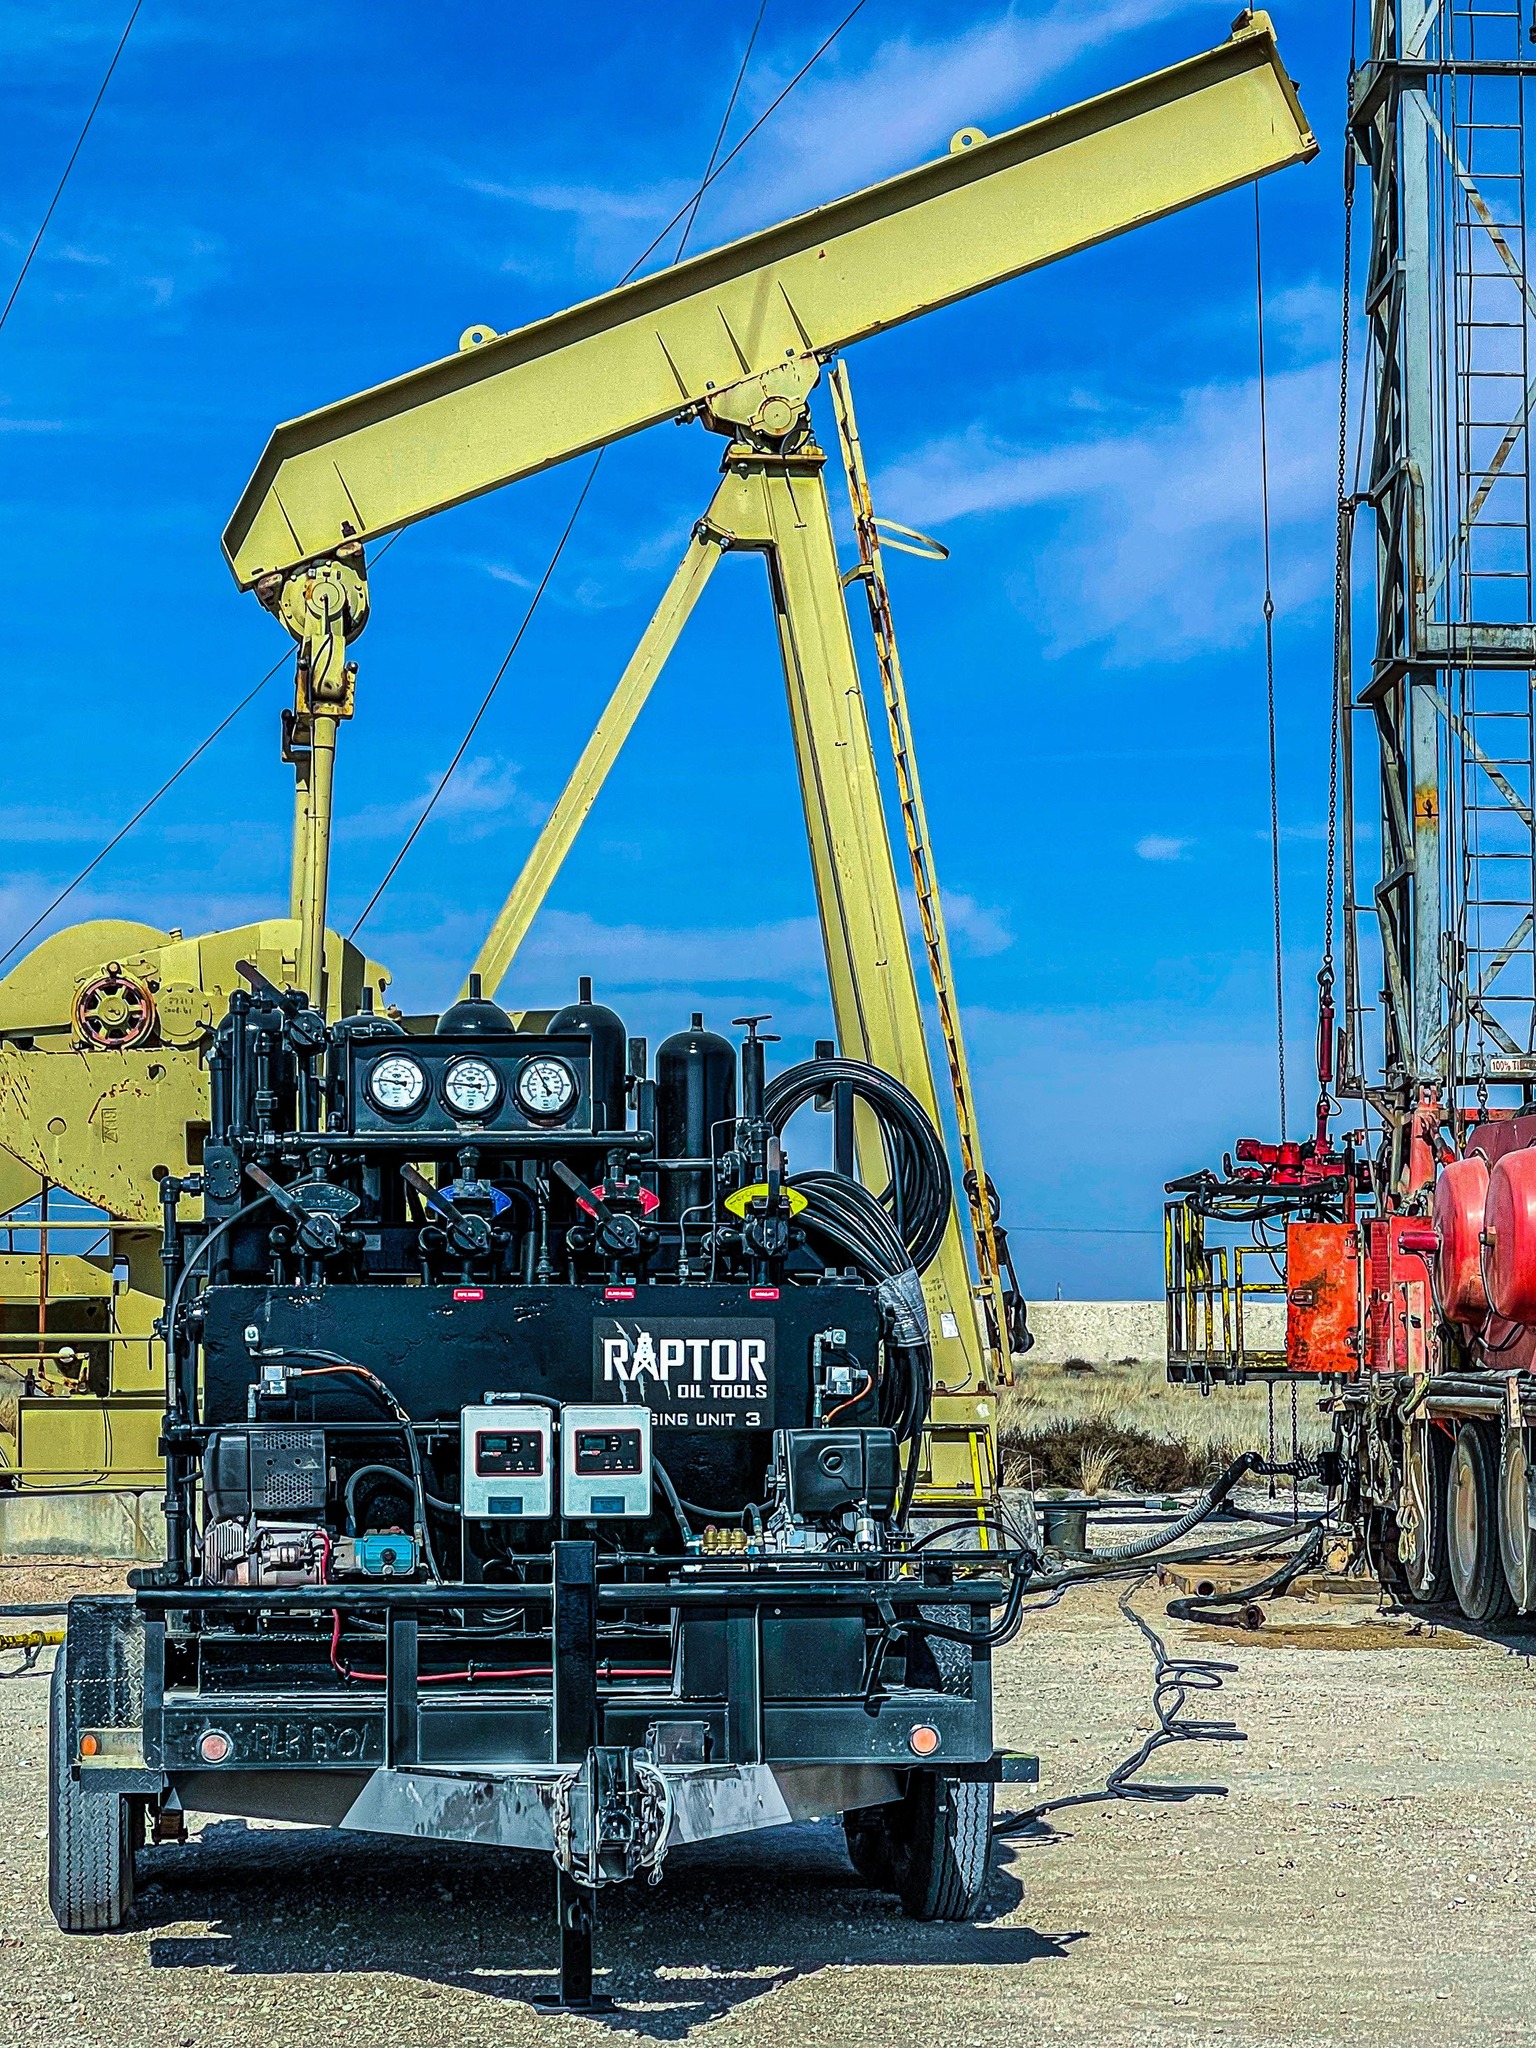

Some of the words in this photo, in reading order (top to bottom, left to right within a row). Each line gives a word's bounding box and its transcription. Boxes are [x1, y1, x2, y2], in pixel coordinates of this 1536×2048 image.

[1492, 1060, 1511, 1071] 100%
[604, 1332, 767, 1381] RAPTOR
[677, 1384, 705, 1398] OIL
[710, 1384, 767, 1398] TOOLS
[696, 1413, 736, 1426] UNIT
[745, 1411, 761, 1426] 3
